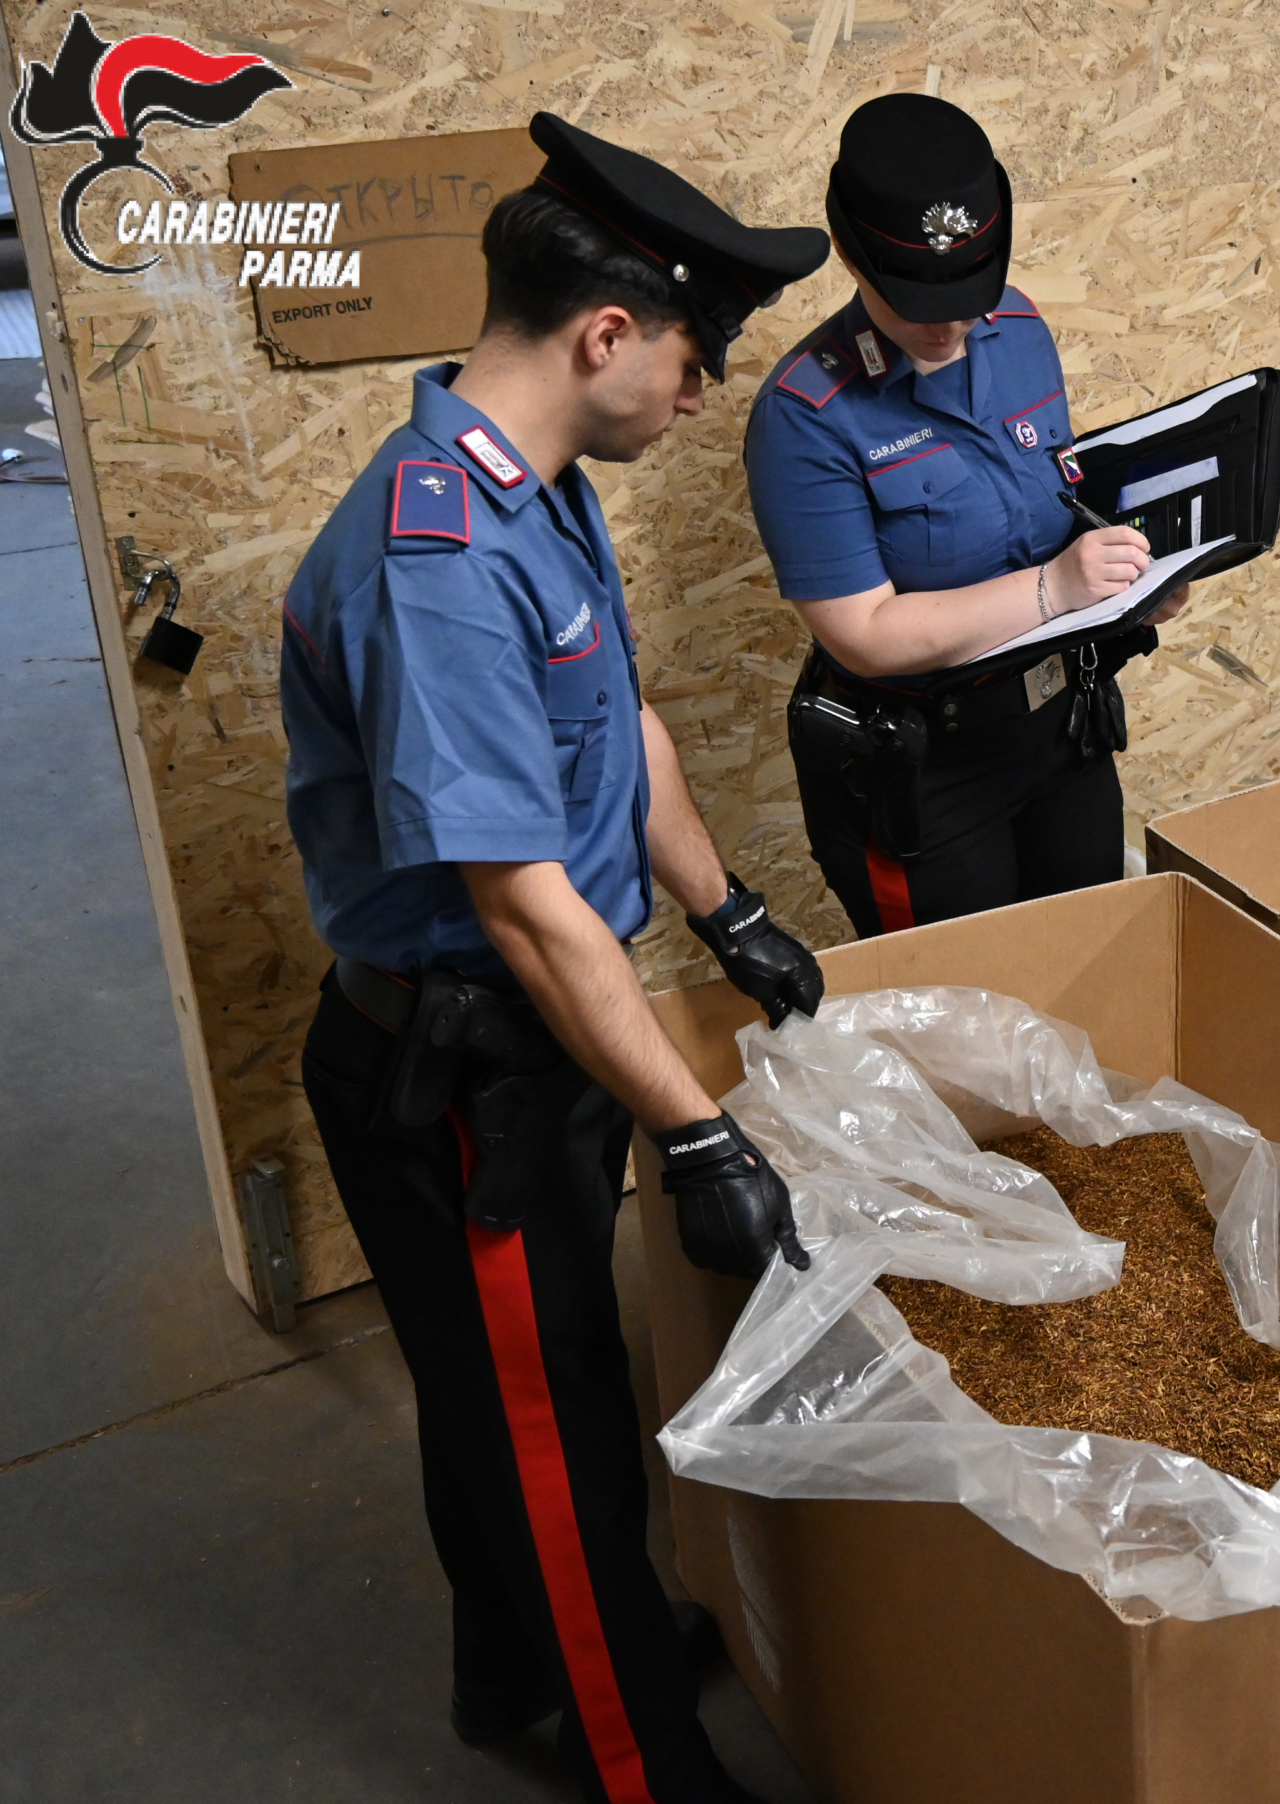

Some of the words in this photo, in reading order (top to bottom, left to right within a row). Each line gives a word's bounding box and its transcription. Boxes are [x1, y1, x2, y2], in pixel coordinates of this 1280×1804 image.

[272, 303, 332, 324] EXPORT
[336, 296, 373, 314] ONLY
[868, 427, 934, 461] CARABINIERI
[669, 1130, 730, 1155] CARABINIERI
